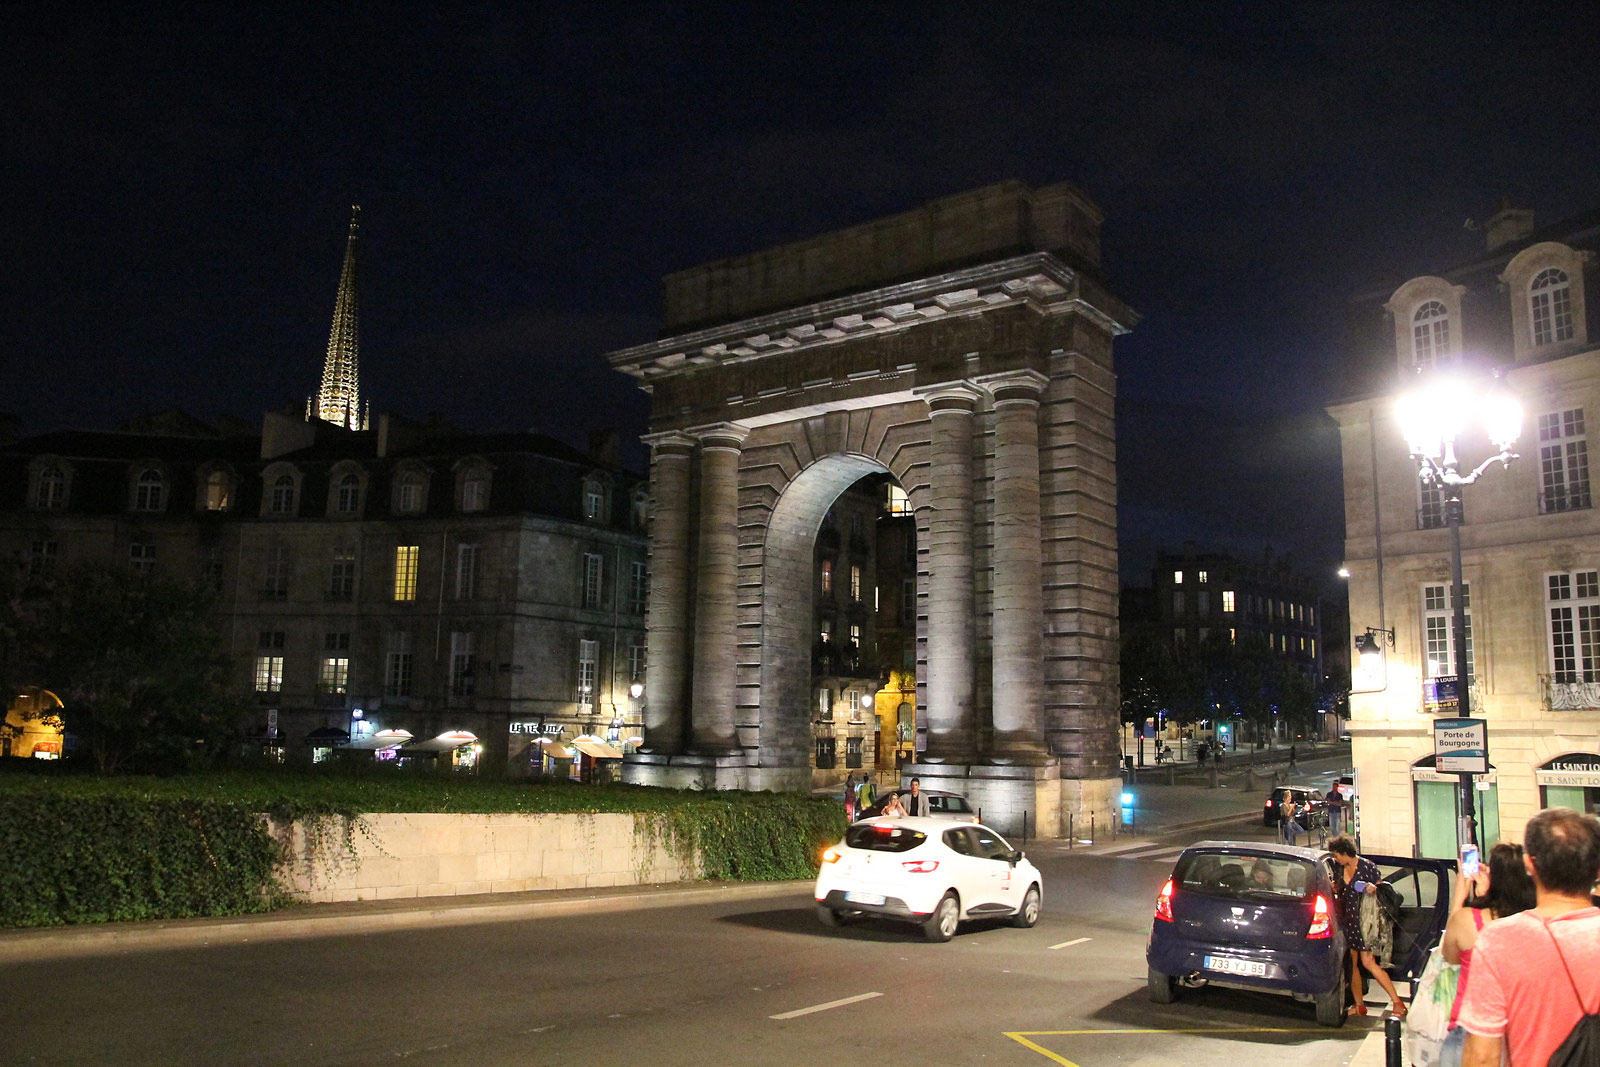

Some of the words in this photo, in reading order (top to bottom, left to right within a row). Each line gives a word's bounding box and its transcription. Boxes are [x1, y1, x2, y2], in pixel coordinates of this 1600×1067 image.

[509, 722, 521, 733] LE
[523, 722, 566, 734] TEUILA
[1439, 739, 1480, 748] Bourgogne
[1552, 762, 1561, 771] LE
[1562, 763, 1587, 772] SAINT
[1543, 776, 1553, 784] LE
[1557, 776, 1583, 785] SAINT
[1211, 958, 1230, 970] 733
[1234, 961, 1247, 973] YJ
[1251, 963, 1264, 974] 85
